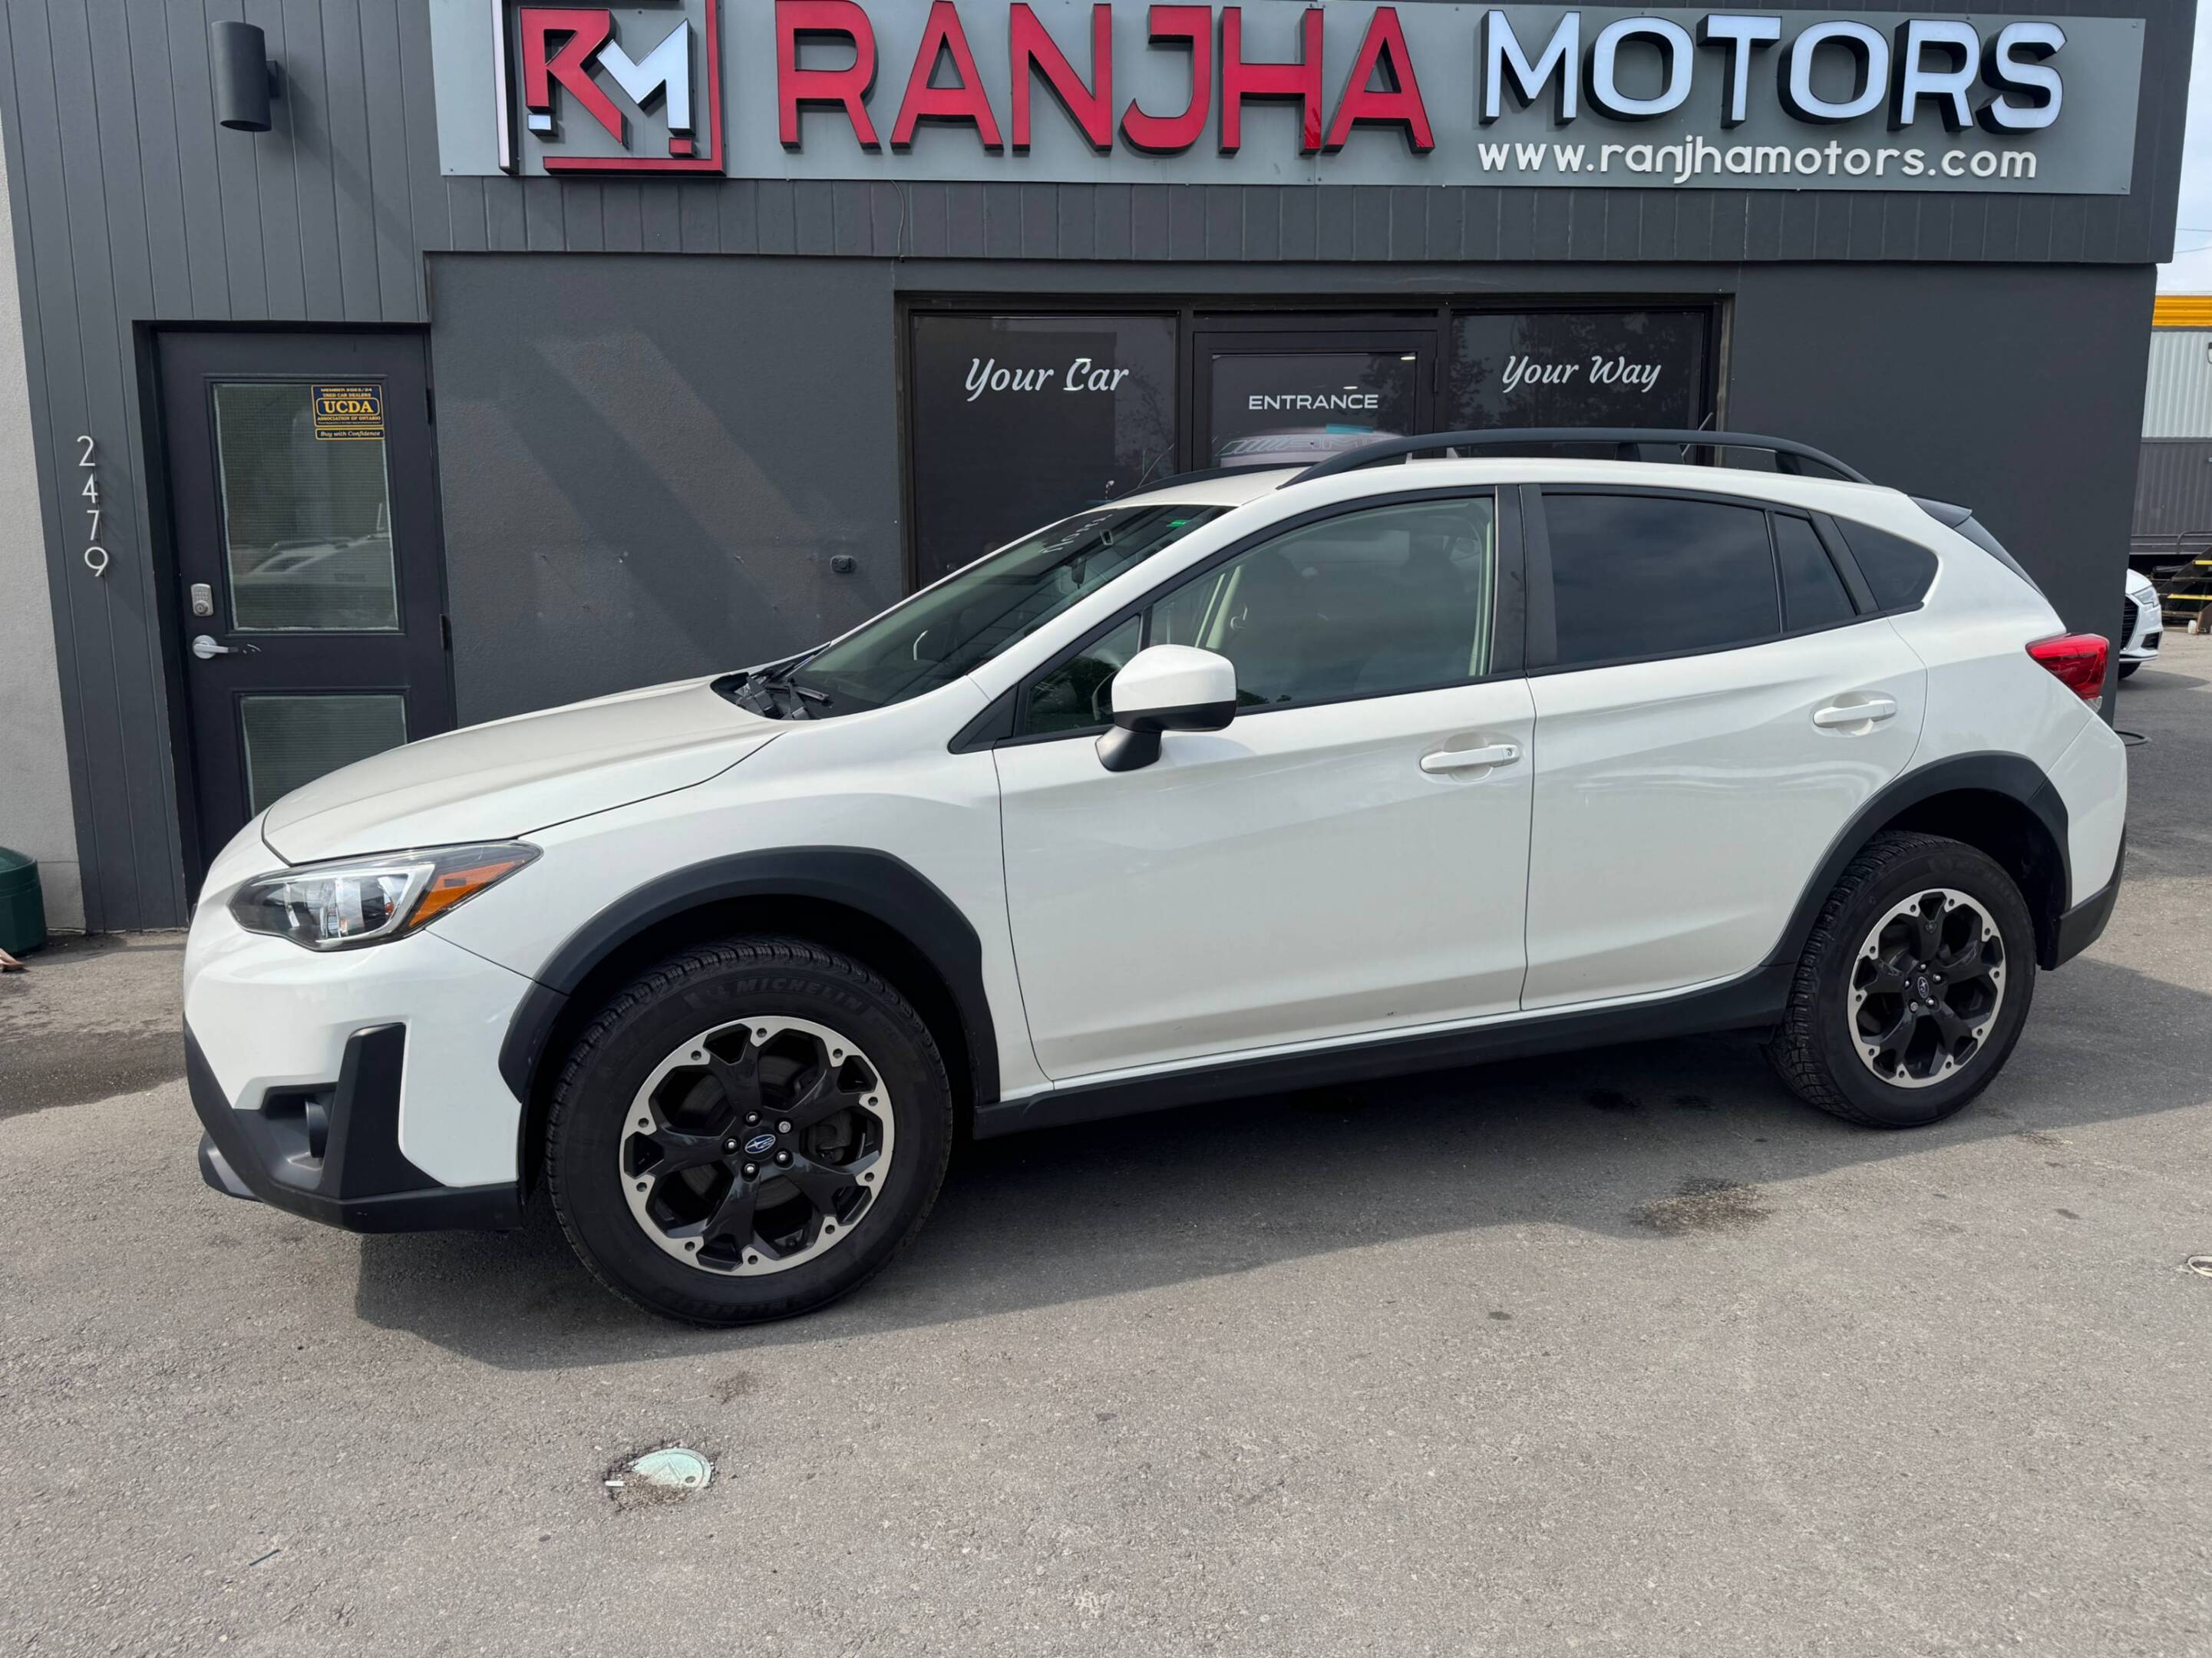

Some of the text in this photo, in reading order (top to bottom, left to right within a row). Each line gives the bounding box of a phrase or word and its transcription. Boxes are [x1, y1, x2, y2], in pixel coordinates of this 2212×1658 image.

[520, 8, 692, 157] RM
[775, 0, 2068, 154] RANJHA MOTORS
[1477, 135, 2037, 185] www.ranjhamotors.com
[965, 358, 1129, 402] Your Car
[1502, 355, 1662, 393] Your Way
[323, 401, 374, 413] UCDA
[1248, 394, 1378, 410] ENTRANCE
[77, 434, 109, 577] 2479
[736, 977, 863, 1010] MICHELIN
